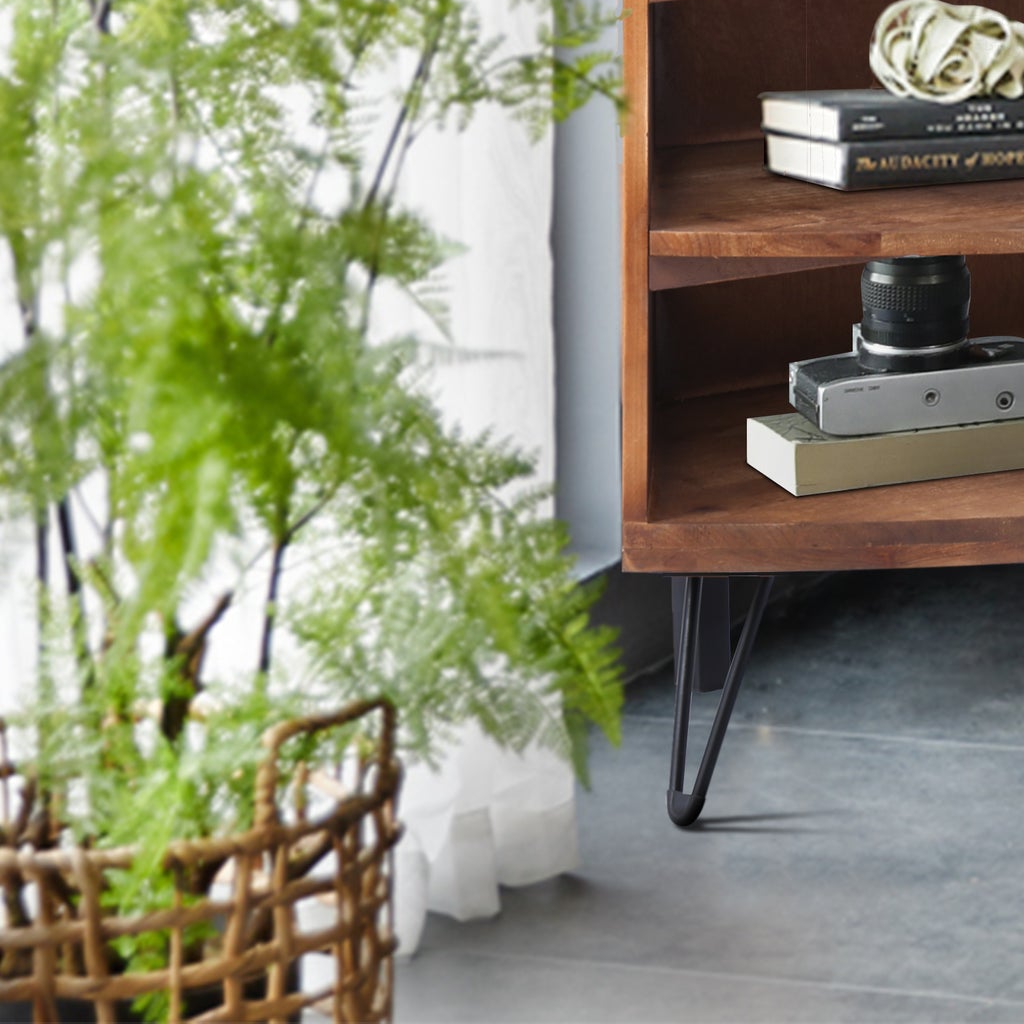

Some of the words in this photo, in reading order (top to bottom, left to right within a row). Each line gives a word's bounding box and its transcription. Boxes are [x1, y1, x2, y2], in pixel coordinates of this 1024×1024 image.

[855, 155, 877, 171] The
[879, 153, 960, 169] AUDACITY
[964, 151, 979, 172] of
